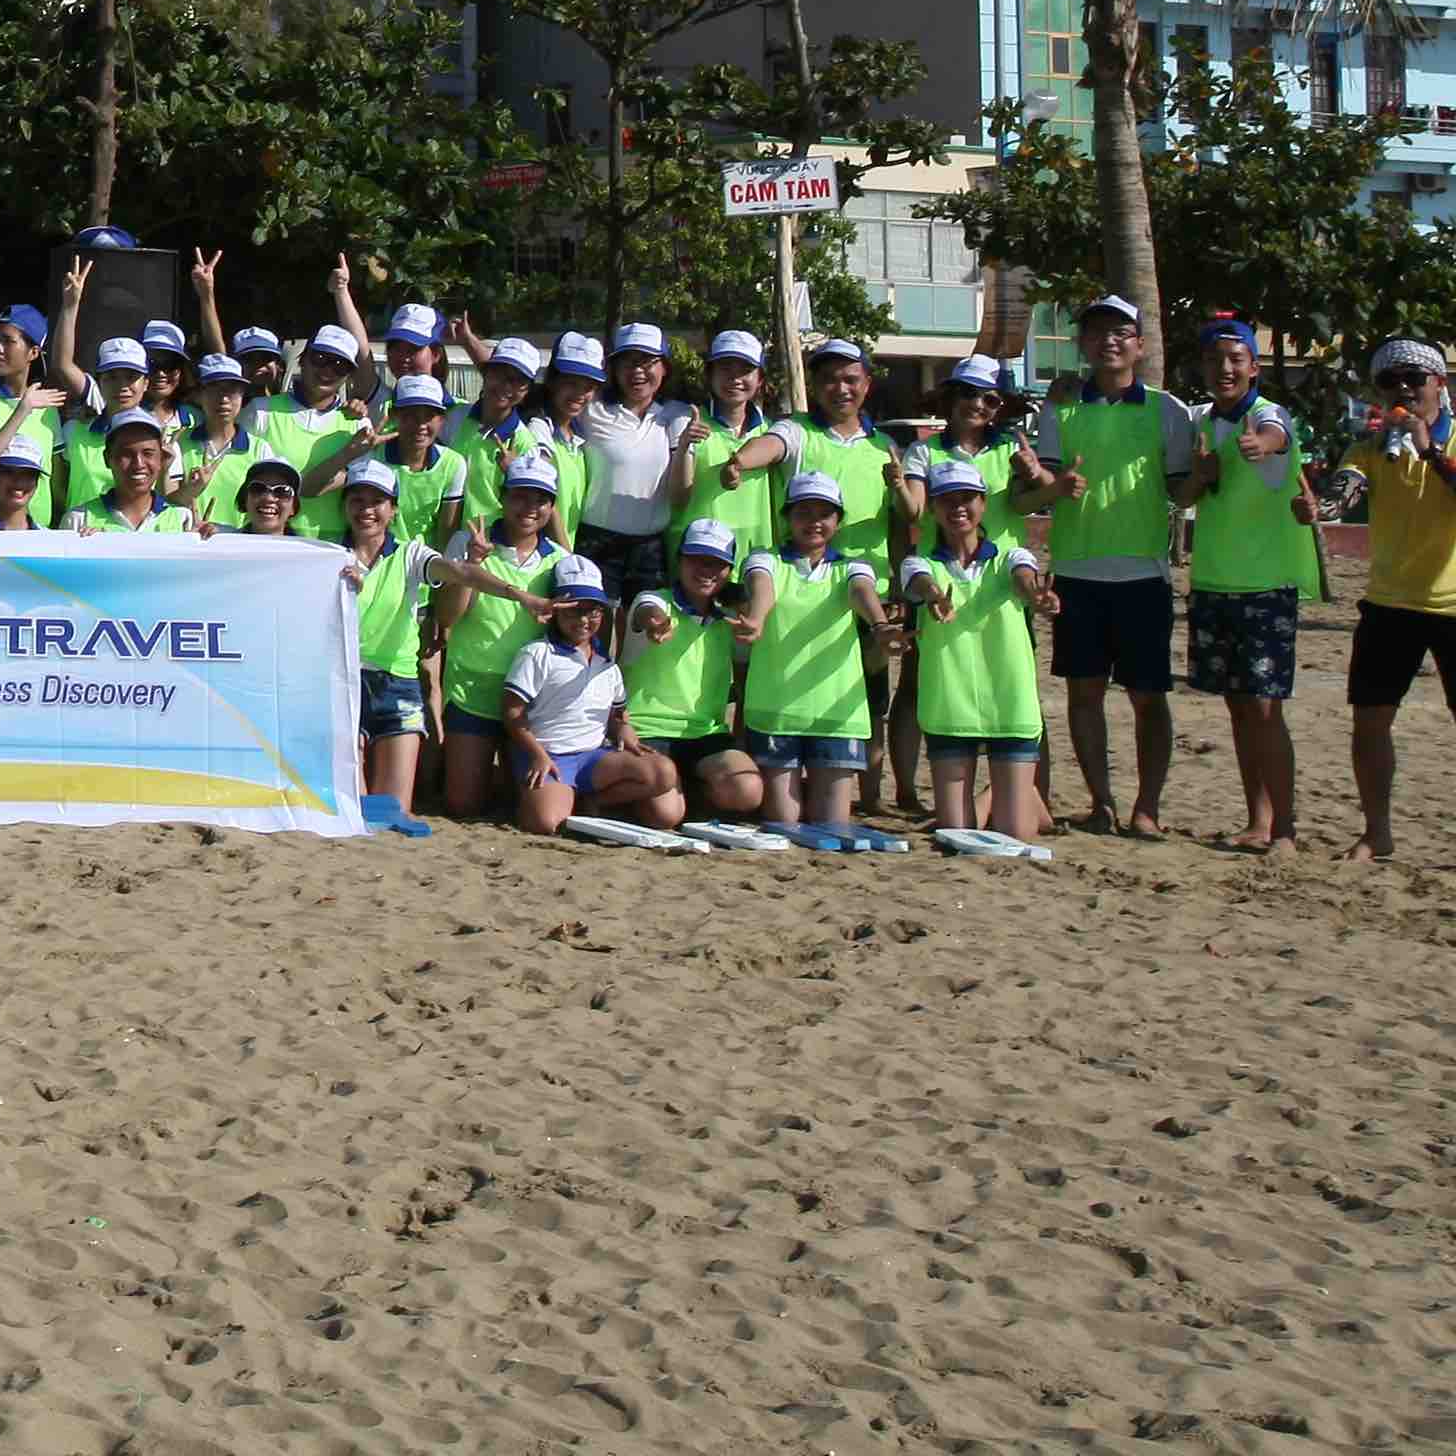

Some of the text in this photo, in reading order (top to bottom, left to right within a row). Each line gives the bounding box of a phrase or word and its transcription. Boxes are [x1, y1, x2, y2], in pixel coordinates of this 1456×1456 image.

[729, 173, 831, 204] CẤM TẮM
[41, 674, 176, 713] Discovery
